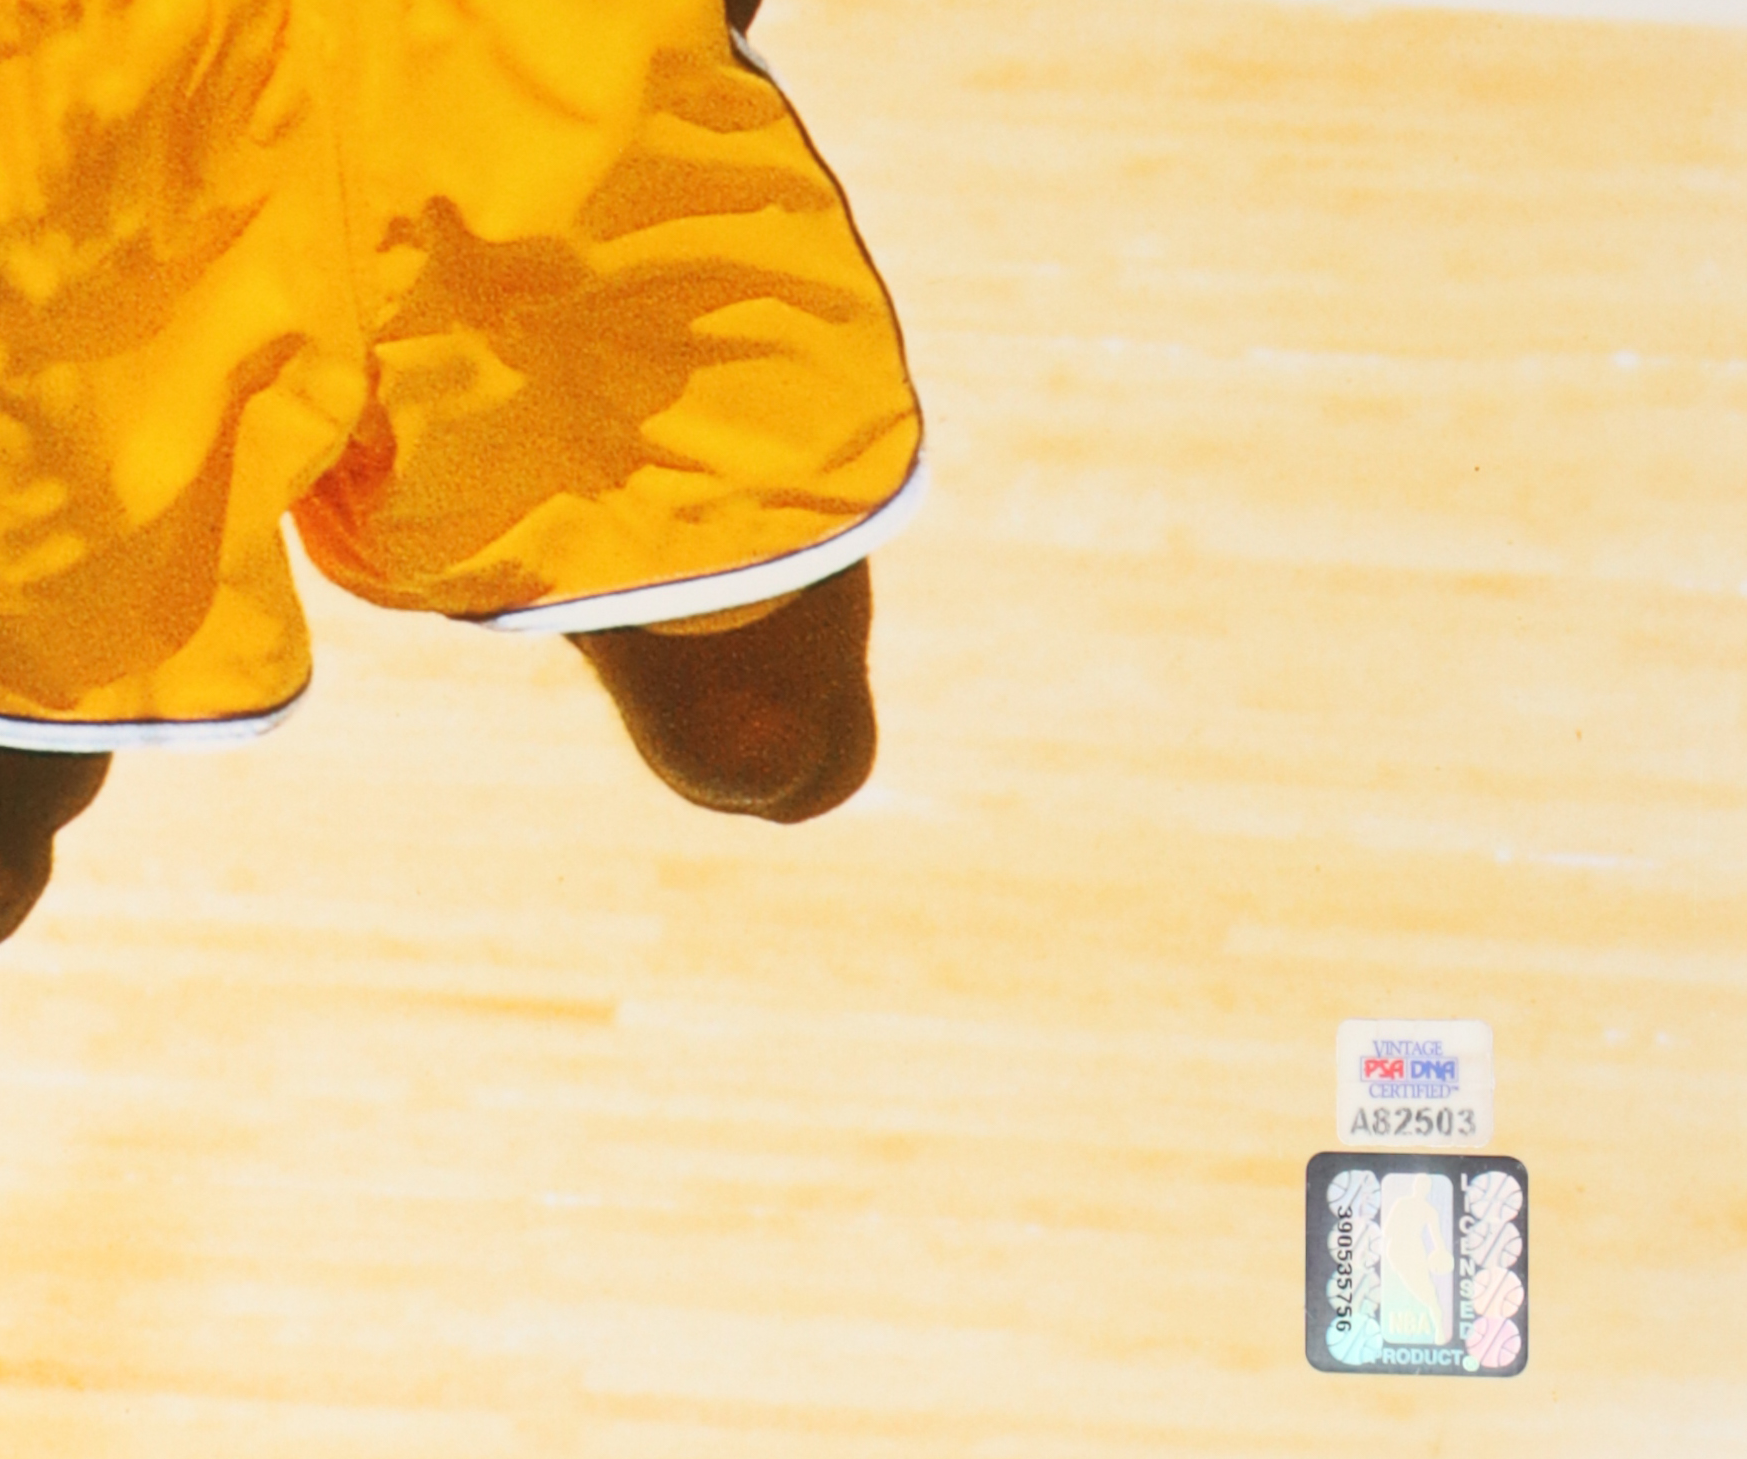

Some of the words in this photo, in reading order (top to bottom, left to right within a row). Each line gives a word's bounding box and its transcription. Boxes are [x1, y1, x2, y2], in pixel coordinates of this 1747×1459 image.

[1372, 1039, 1444, 1058] VINTAGE
[1364, 1058, 1405, 1080] PSA
[1410, 1060, 1456, 1081] DNA
[1350, 1106, 1477, 1137] A82503
[1335, 1205, 1354, 1333] 390535756
